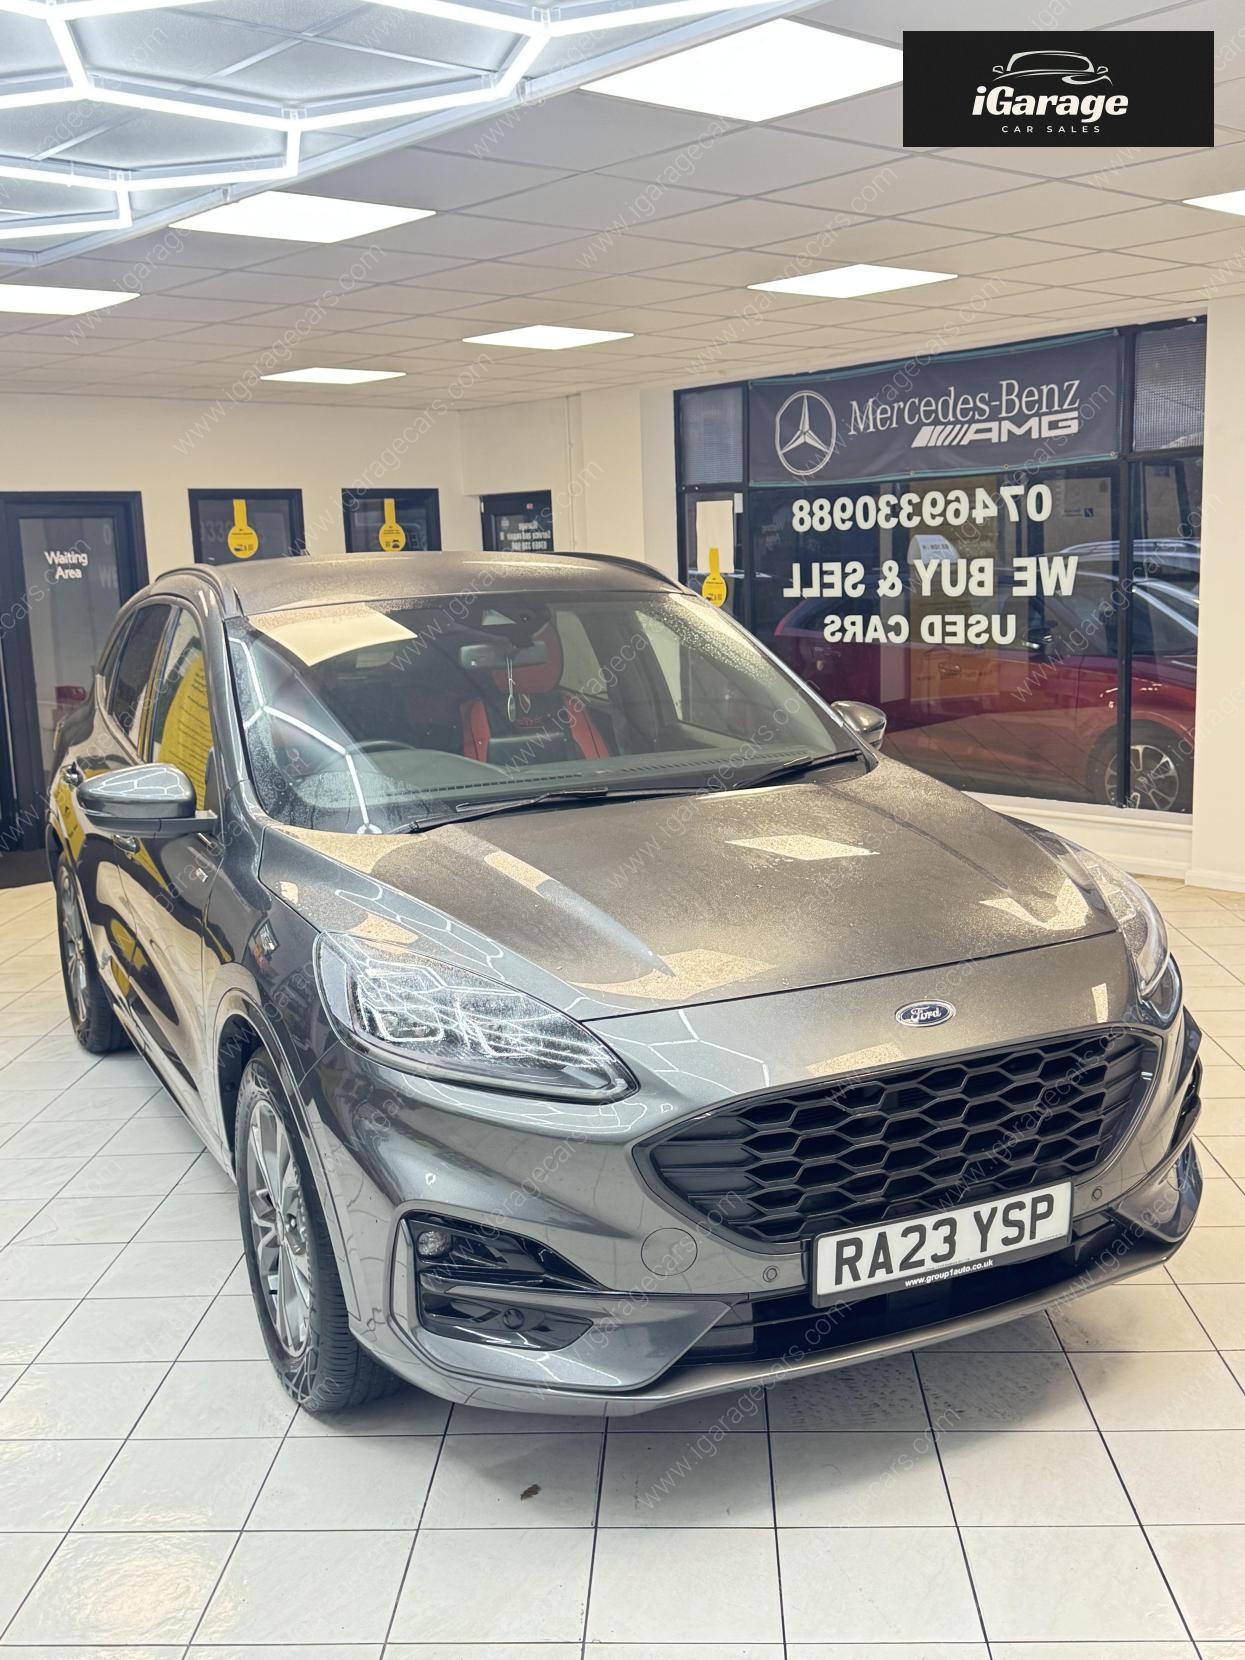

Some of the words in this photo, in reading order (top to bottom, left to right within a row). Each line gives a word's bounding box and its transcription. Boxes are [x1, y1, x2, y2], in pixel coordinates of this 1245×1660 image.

[848, 379, 1081, 435] Mercedes-Benz
[959, 411, 1079, 445] AMG
[44, 550, 89, 566] Waiting
[55, 566, 83, 579] Area
[909, 1005, 943, 1023] Ford
[834, 1215, 957, 1287] RA23
[973, 1193, 1055, 1253] YSP
[904, 1259, 994, 1287] www.group1auto.co.uk
